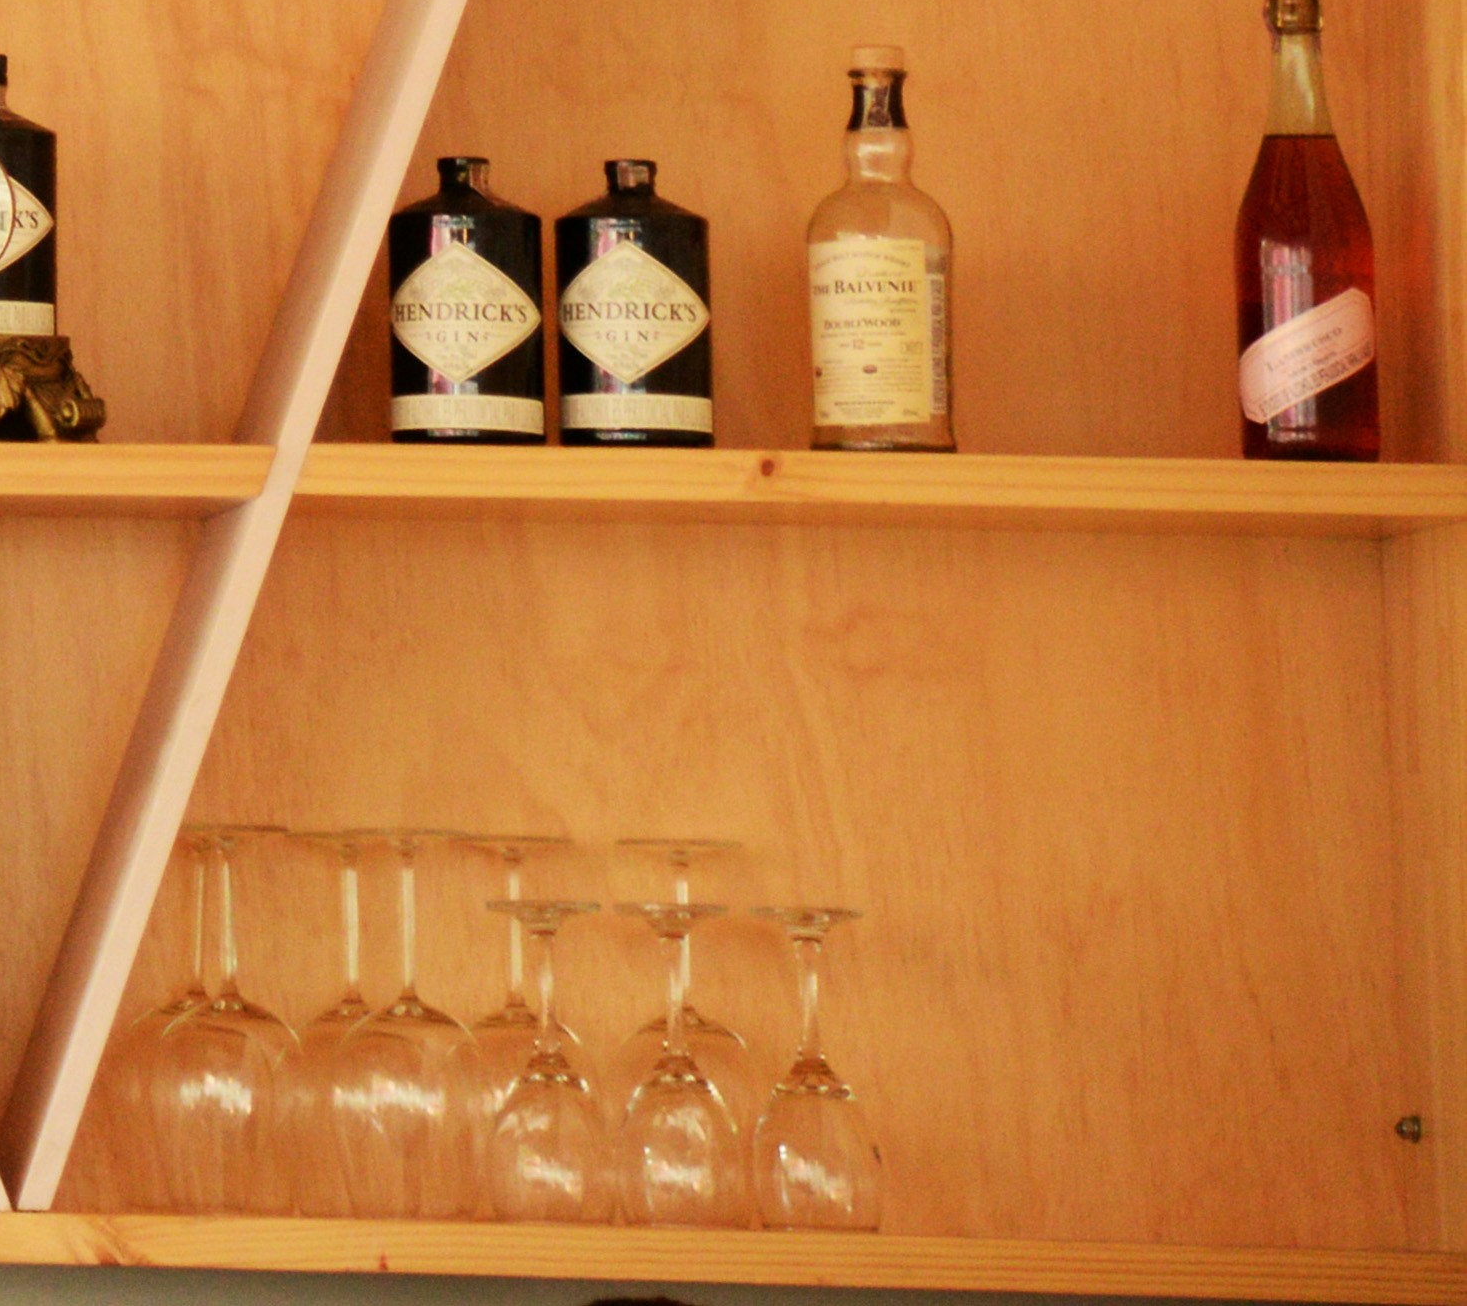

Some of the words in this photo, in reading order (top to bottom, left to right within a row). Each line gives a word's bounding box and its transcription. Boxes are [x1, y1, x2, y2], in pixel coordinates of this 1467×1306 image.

[394, 303, 529, 324] HENDRICK'S
[562, 302, 698, 324] HENDRICK'S
[435, 331, 480, 344] GIN
[605, 330, 650, 344] GIN
